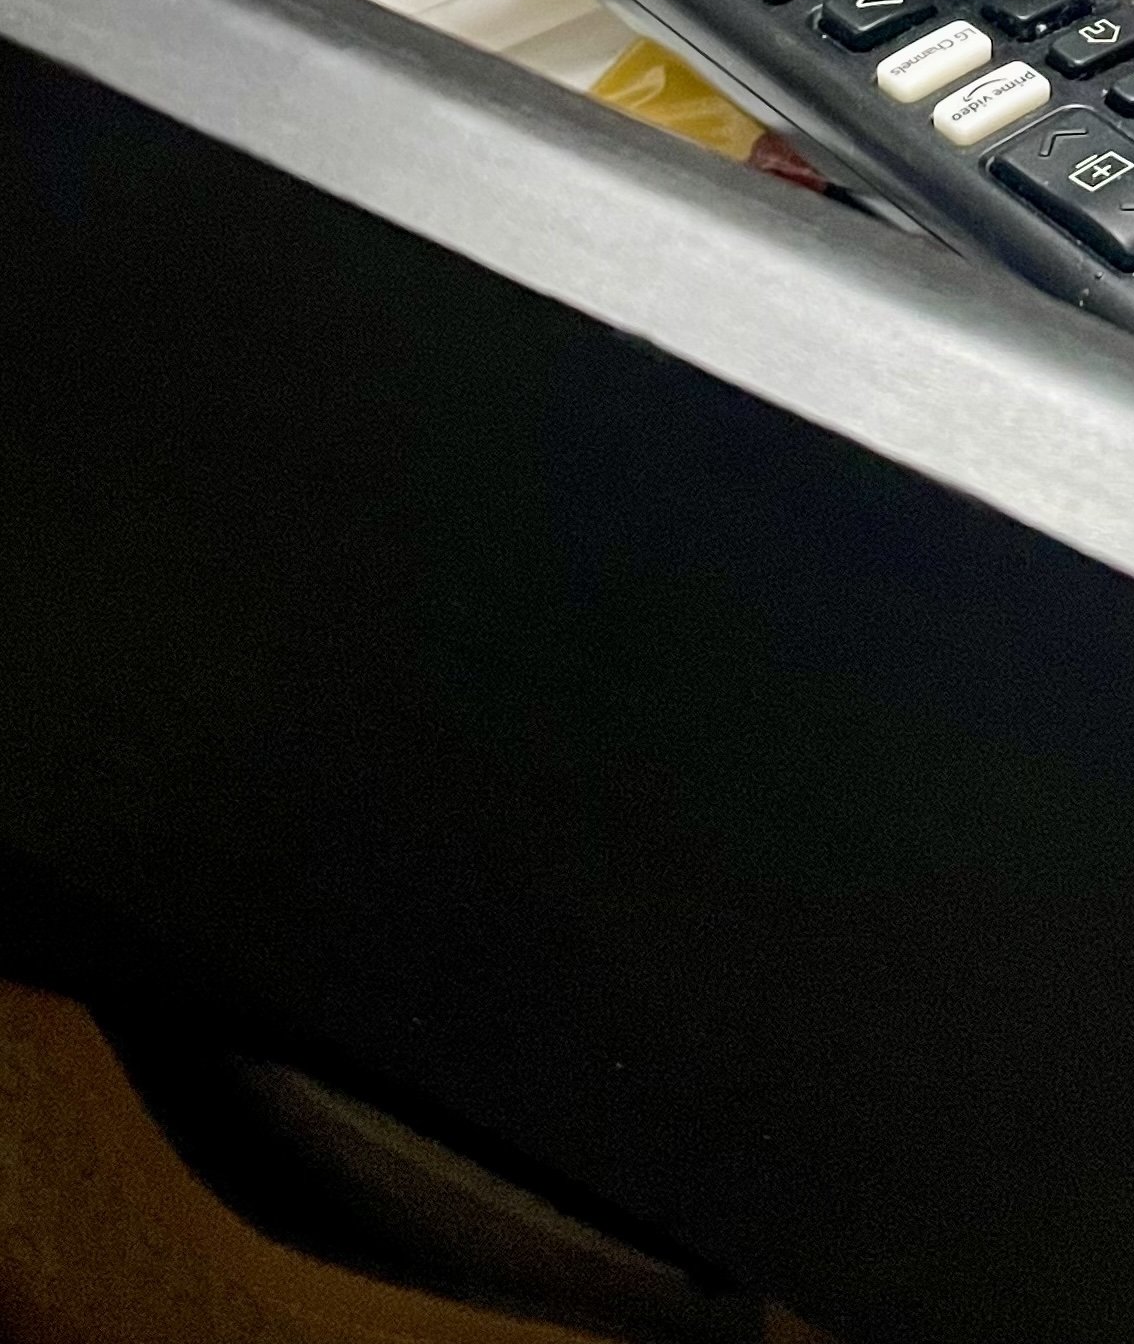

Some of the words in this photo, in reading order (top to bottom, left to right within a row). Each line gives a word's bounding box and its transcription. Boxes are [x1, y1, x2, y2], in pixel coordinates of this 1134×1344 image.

[951, 26, 979, 45] LG
[888, 39, 955, 79] Channels
[990, 70, 1037, 104] prime
[950, 95, 996, 124] video
